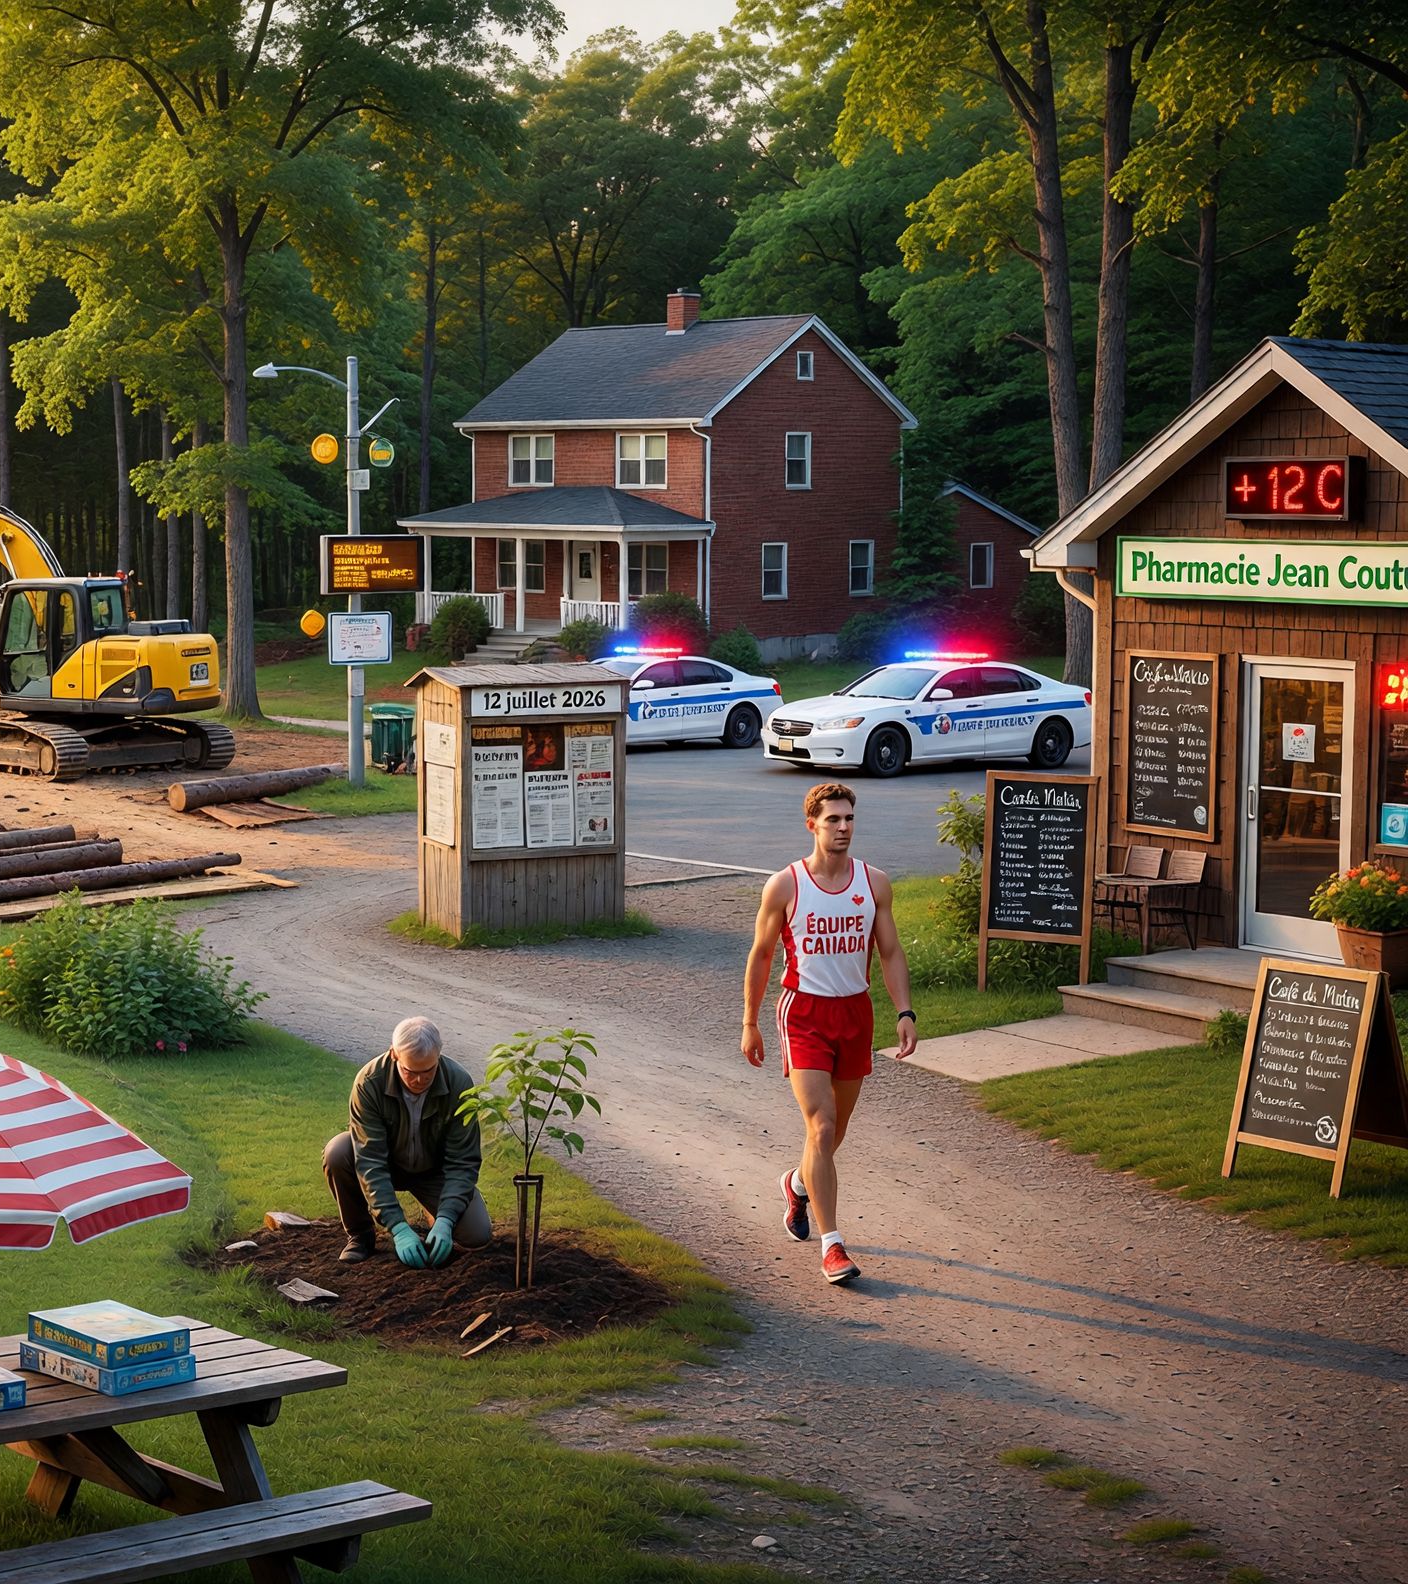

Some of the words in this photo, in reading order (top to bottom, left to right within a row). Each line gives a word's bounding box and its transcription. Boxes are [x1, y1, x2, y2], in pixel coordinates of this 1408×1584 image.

[1131, 550, 1261, 587] Pharmacie
[1267, 553, 1329, 588] Jean
[1338, 554, 1408, 590] Cout
[483, 692, 501, 711] 12
[503, 690, 557, 715] juillet
[561, 690, 606, 708] 2026
[806, 911, 865, 935] ÉQUIPE
